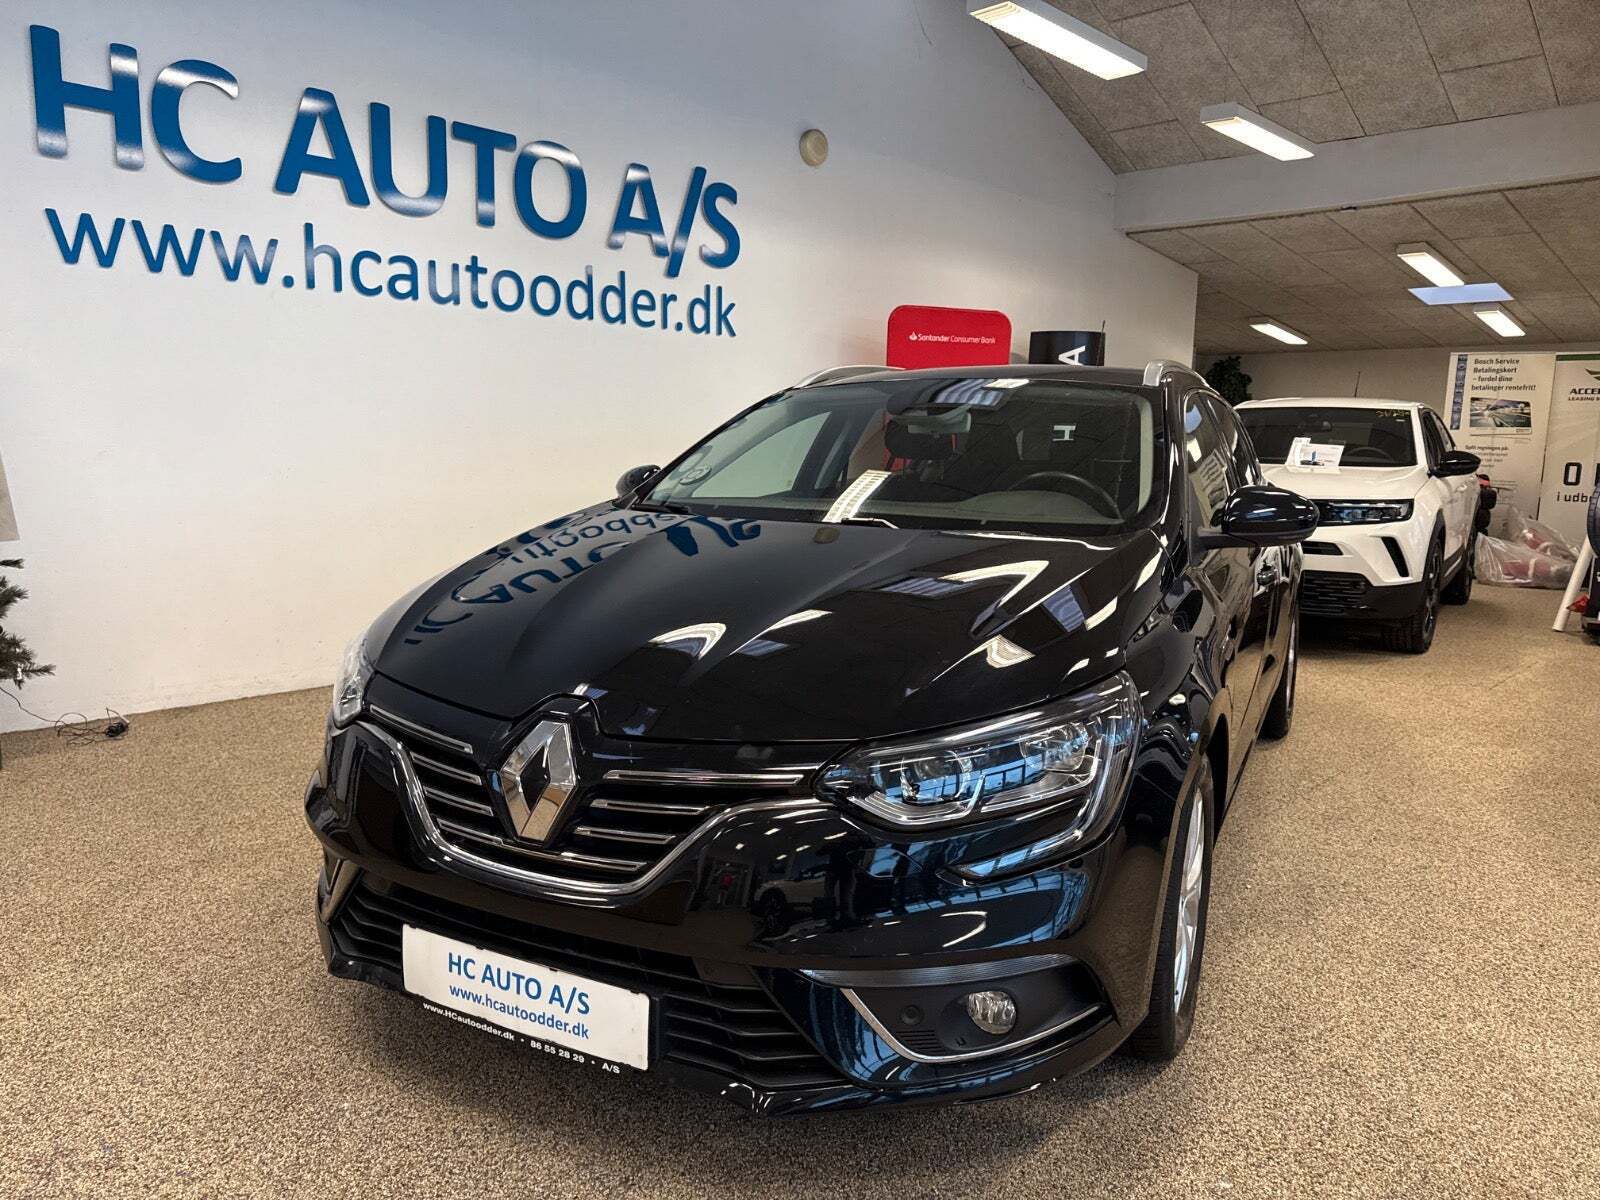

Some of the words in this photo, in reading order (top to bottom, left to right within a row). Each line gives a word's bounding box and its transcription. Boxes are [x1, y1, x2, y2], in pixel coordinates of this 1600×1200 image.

[29, 24, 242, 184] HC
[273, 87, 588, 239] AUTO
[608, 163, 741, 278] A/S
[44, 207, 738, 338] www.hcautoodder.dk
[918, 334, 950, 342] Santander
[950, 335, 981, 344] Consumer
[981, 336, 996, 344] Bank
[1471, 384, 1504, 392] betalinger
[1570, 387, 1600, 395] ACCE
[1564, 492, 1589, 503] udb
[448, 952, 476, 980] HC
[481, 963, 542, 1000] AUTO
[548, 984, 590, 1015] A/S
[423, 1002, 515, 1041] www.HCautoodder.dk
[530, 1040, 542, 1050] 86
[544, 1044, 556, 1055] 55
[558, 1048, 570, 1059] 28
[572, 1053, 585, 1063] 29
[602, 1062, 621, 1074] A/S
[449, 985, 589, 1040] www.hcautoodder.dk
